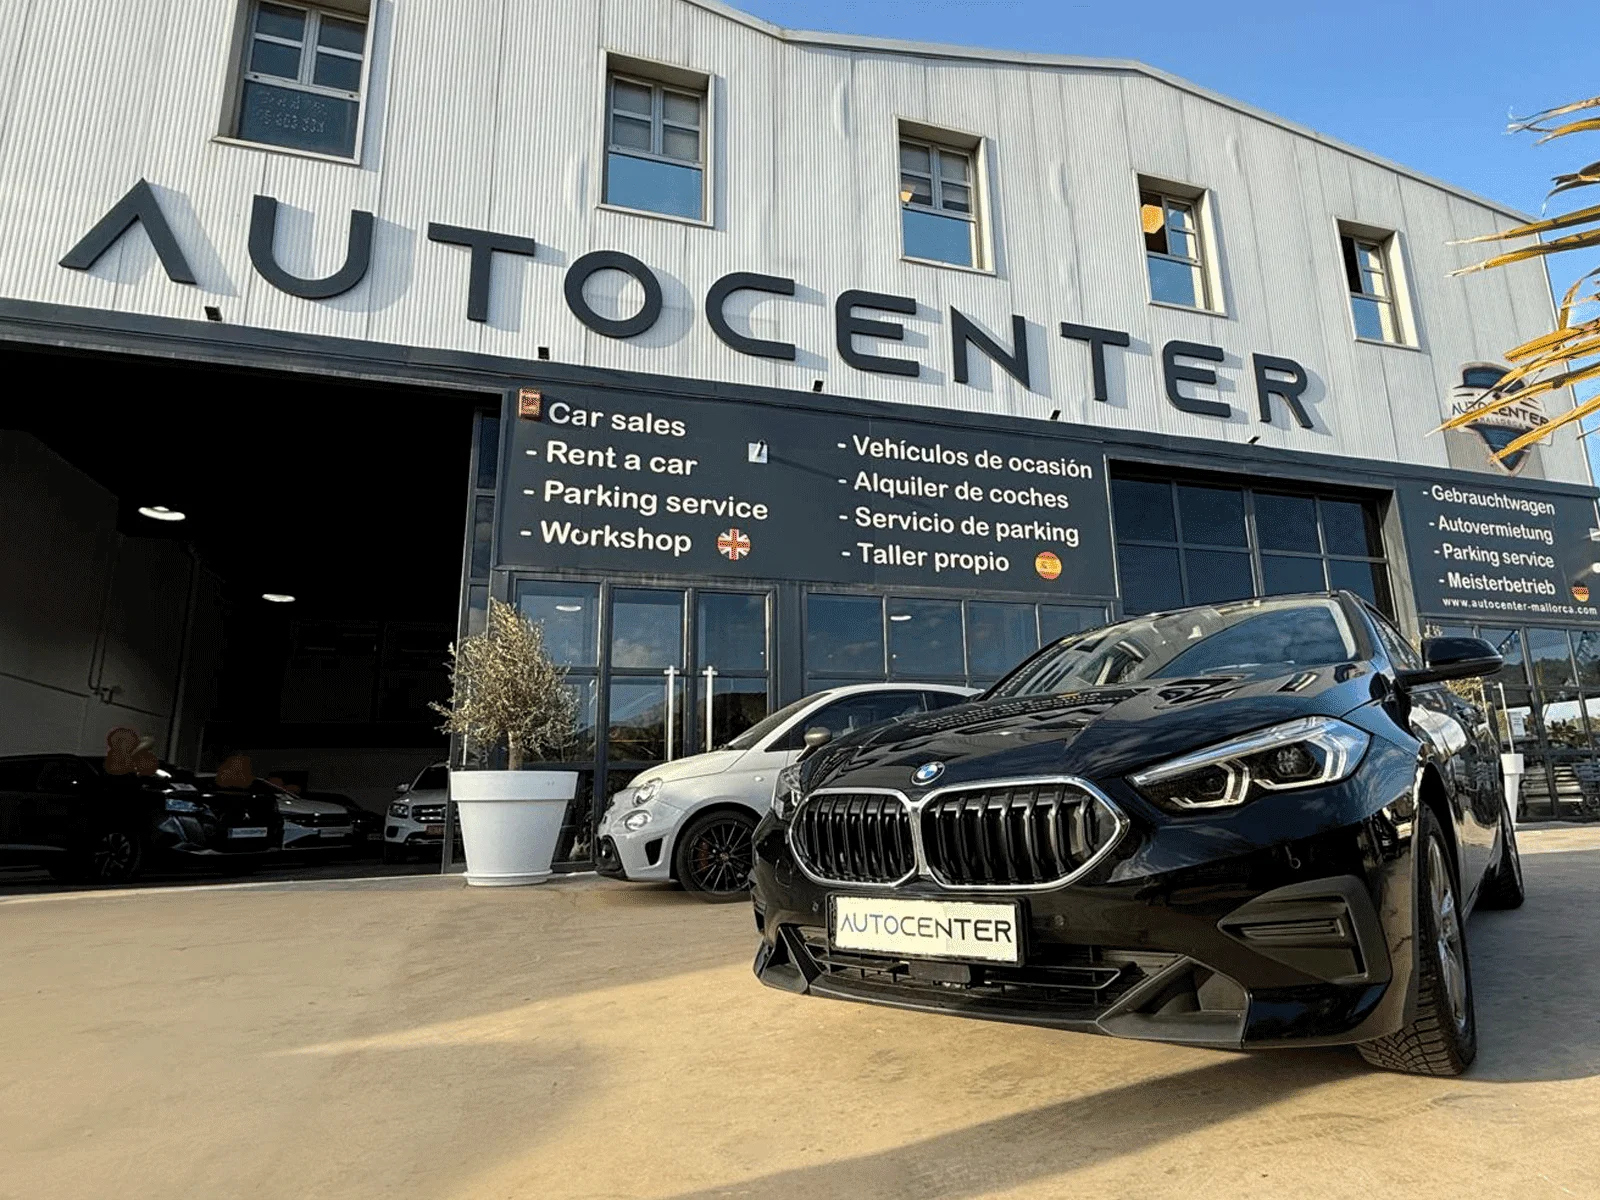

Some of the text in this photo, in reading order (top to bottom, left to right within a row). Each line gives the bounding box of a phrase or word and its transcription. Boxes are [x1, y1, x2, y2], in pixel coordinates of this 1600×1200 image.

[58, 177, 1313, 428] AUTOCENTER
[549, 402, 686, 437] Car sales
[546, 440, 698, 475] Rent a car
[853, 434, 1093, 479] Vehículos de ocasión
[544, 480, 768, 519] Parking service
[854, 471, 1069, 509] Alquiler de coches
[1431, 484, 1555, 516] Gebrauchtwagen
[541, 520, 692, 557] Workshop
[855, 506, 1079, 547] Servicio de parking
[1438, 515, 1554, 544] Autovermietung
[857, 542, 1009, 575] Taller propio
[1442, 543, 1555, 568] Parking service
[1447, 572, 1556, 595] Meisterbetrieb
[1442, 598, 1597, 615] www.autocenter-mallorca.com
[841, 913, 1012, 944] AUTOCENTER
